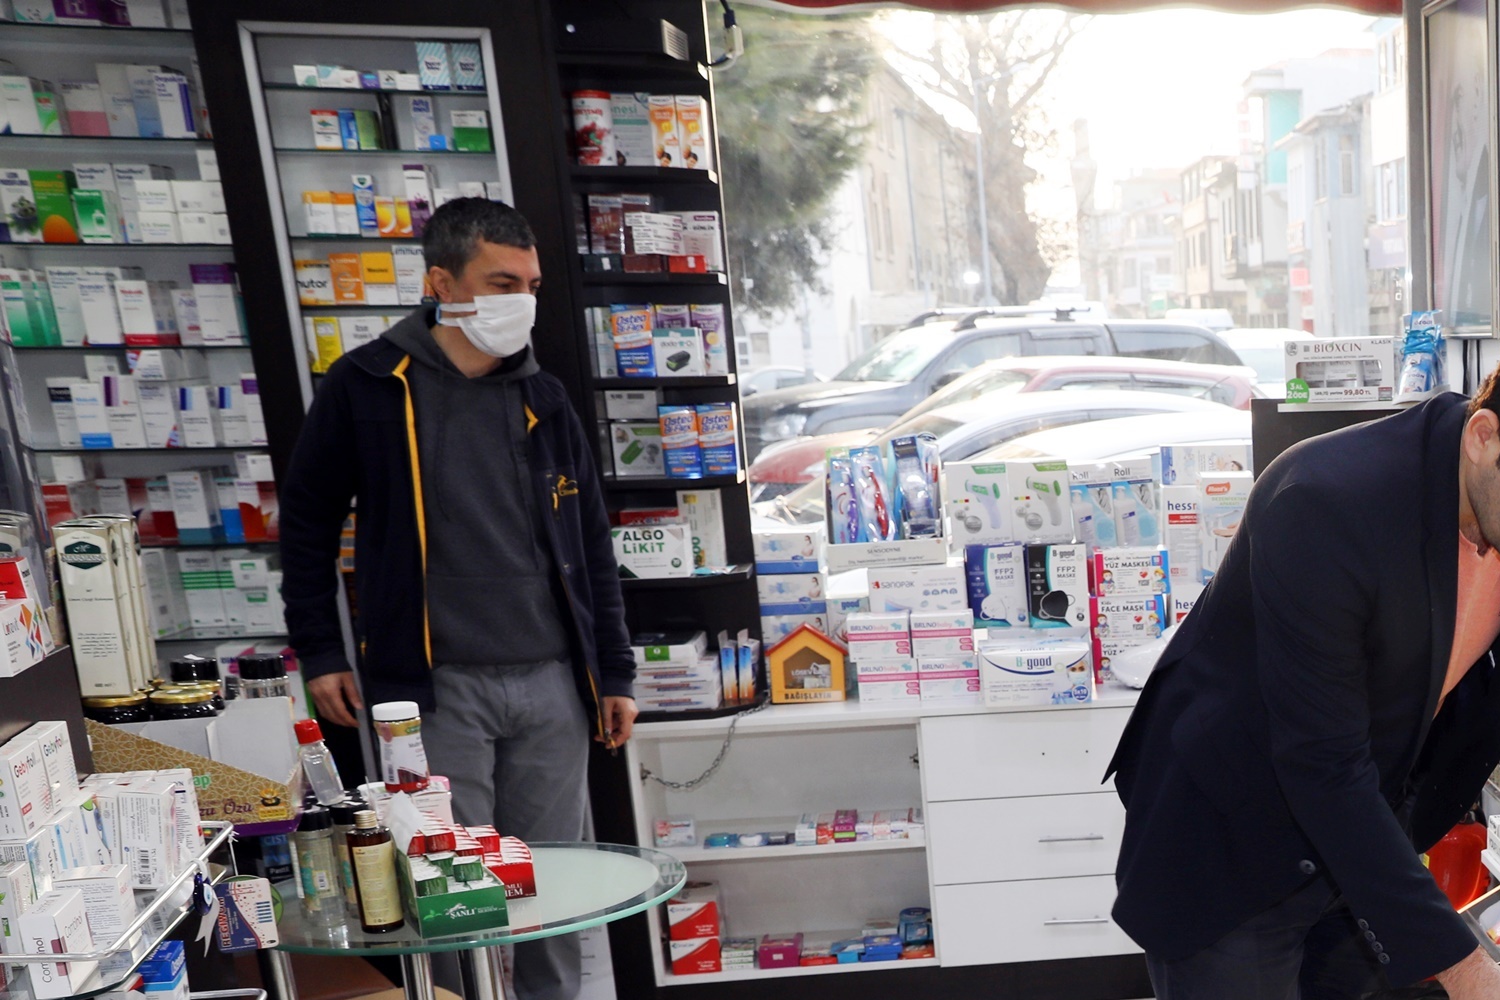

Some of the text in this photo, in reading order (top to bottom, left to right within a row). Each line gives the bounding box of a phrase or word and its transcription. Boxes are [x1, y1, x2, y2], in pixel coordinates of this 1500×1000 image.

[1313, 342, 1362, 353] BIOXCIN
[1114, 467, 1131, 477] Roll
[622, 529, 664, 542] ALGO
[867, 547, 901, 555] SENSODYNE
[1105, 559, 1151, 569] YÜZ MASKESİ
[994, 568, 1015, 576] FFP2
[1101, 604, 1145, 613] FACE MASK
[1103, 647, 1117, 656] YÜZ
[1016, 656, 1052, 670] B-good
[784, 689, 832, 702] BAĞIŞLAYIN
[450, 907, 475, 920] ŞANLI
[33, 936, 53, 984] Cominol
